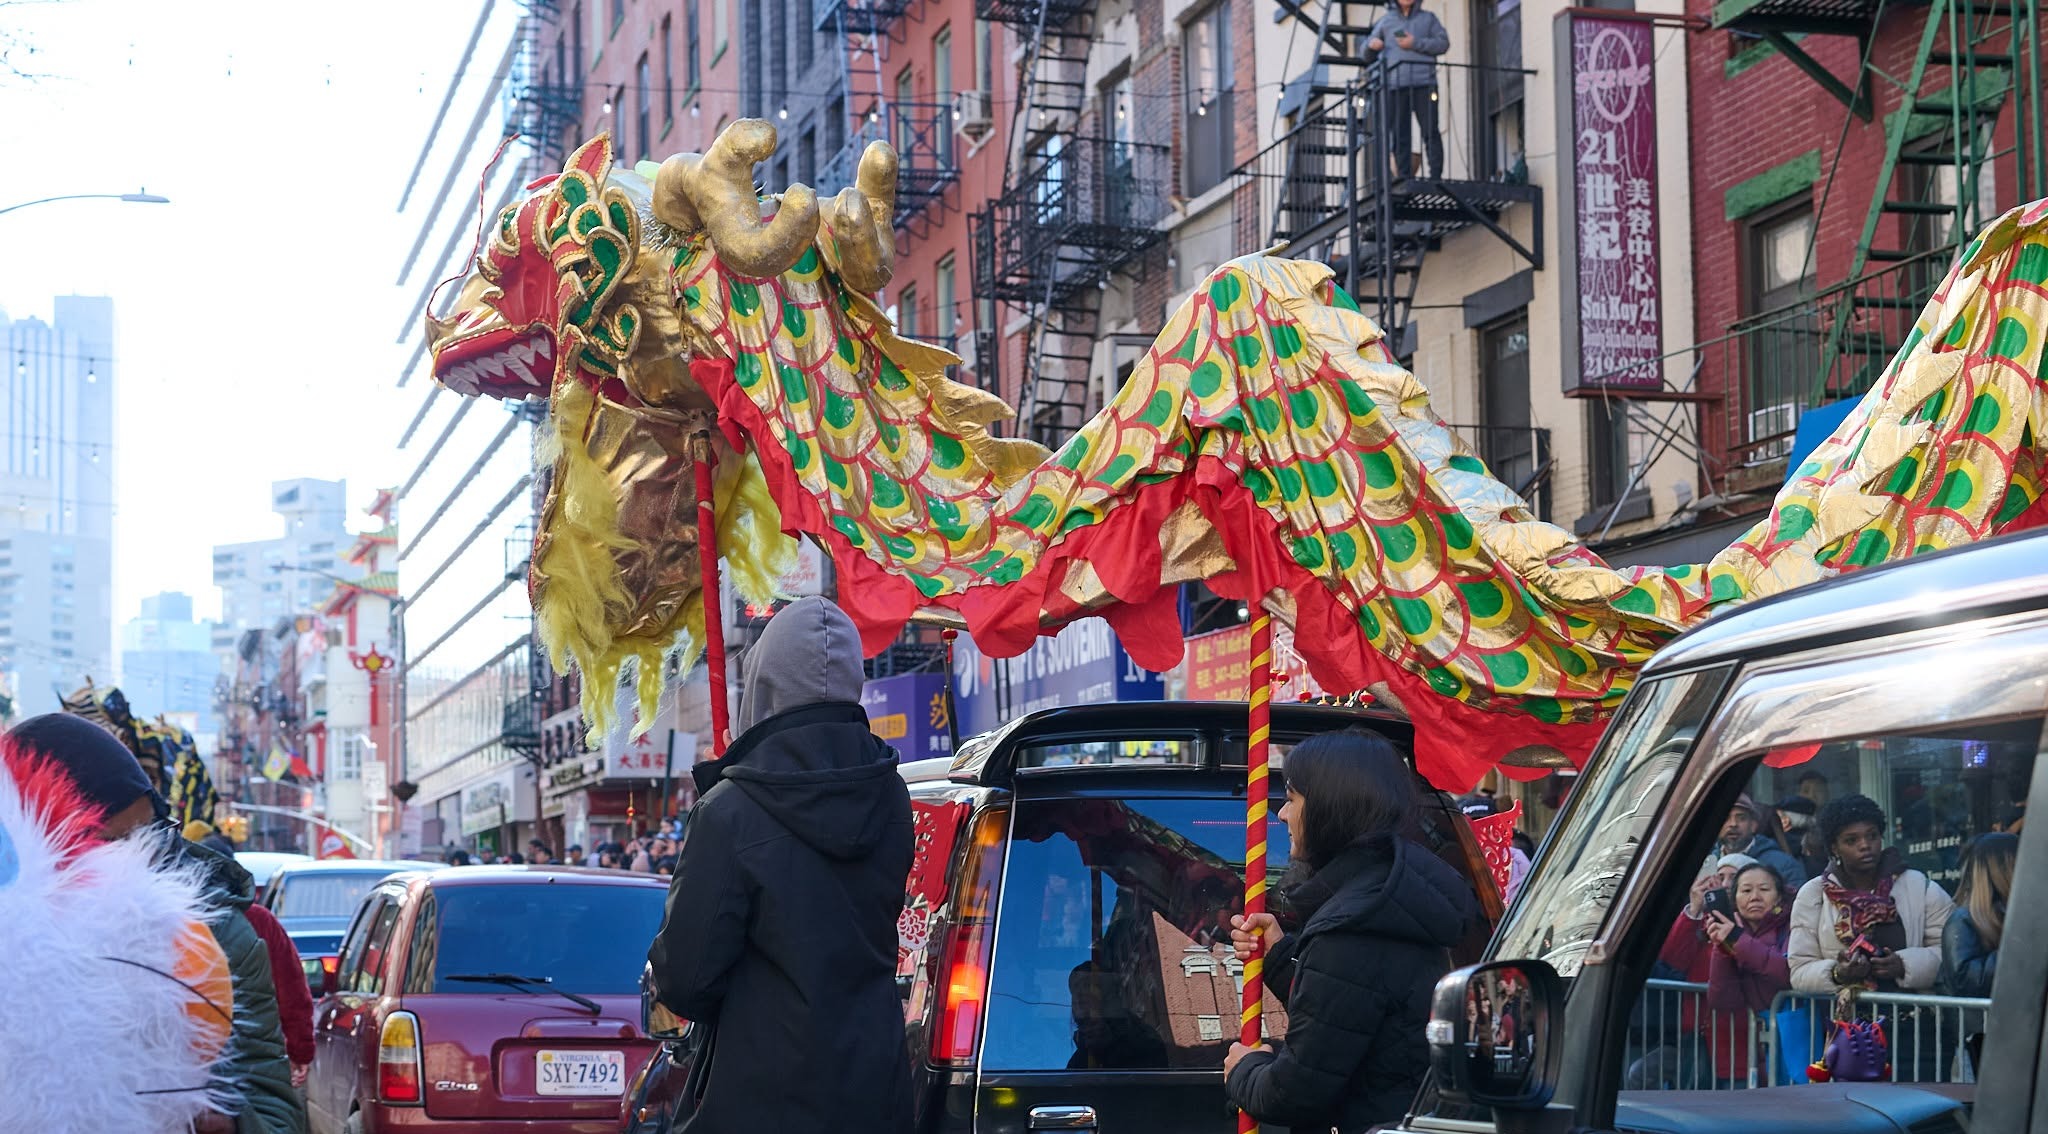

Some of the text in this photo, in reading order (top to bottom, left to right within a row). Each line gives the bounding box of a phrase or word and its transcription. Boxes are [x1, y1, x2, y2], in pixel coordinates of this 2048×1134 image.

[1579, 128, 1619, 164] 21
[1582, 173, 1622, 260] 世紀
[1626, 178, 1654, 291] 美容中心
[1640, 298, 1656, 322] 21
[1047, 617, 1111, 675] SOUVENIR
[619, 753, 667, 770] 大酒家
[543, 1062, 618, 1083] SXY-7492
[559, 1054, 601, 1062] VIRGINIA
